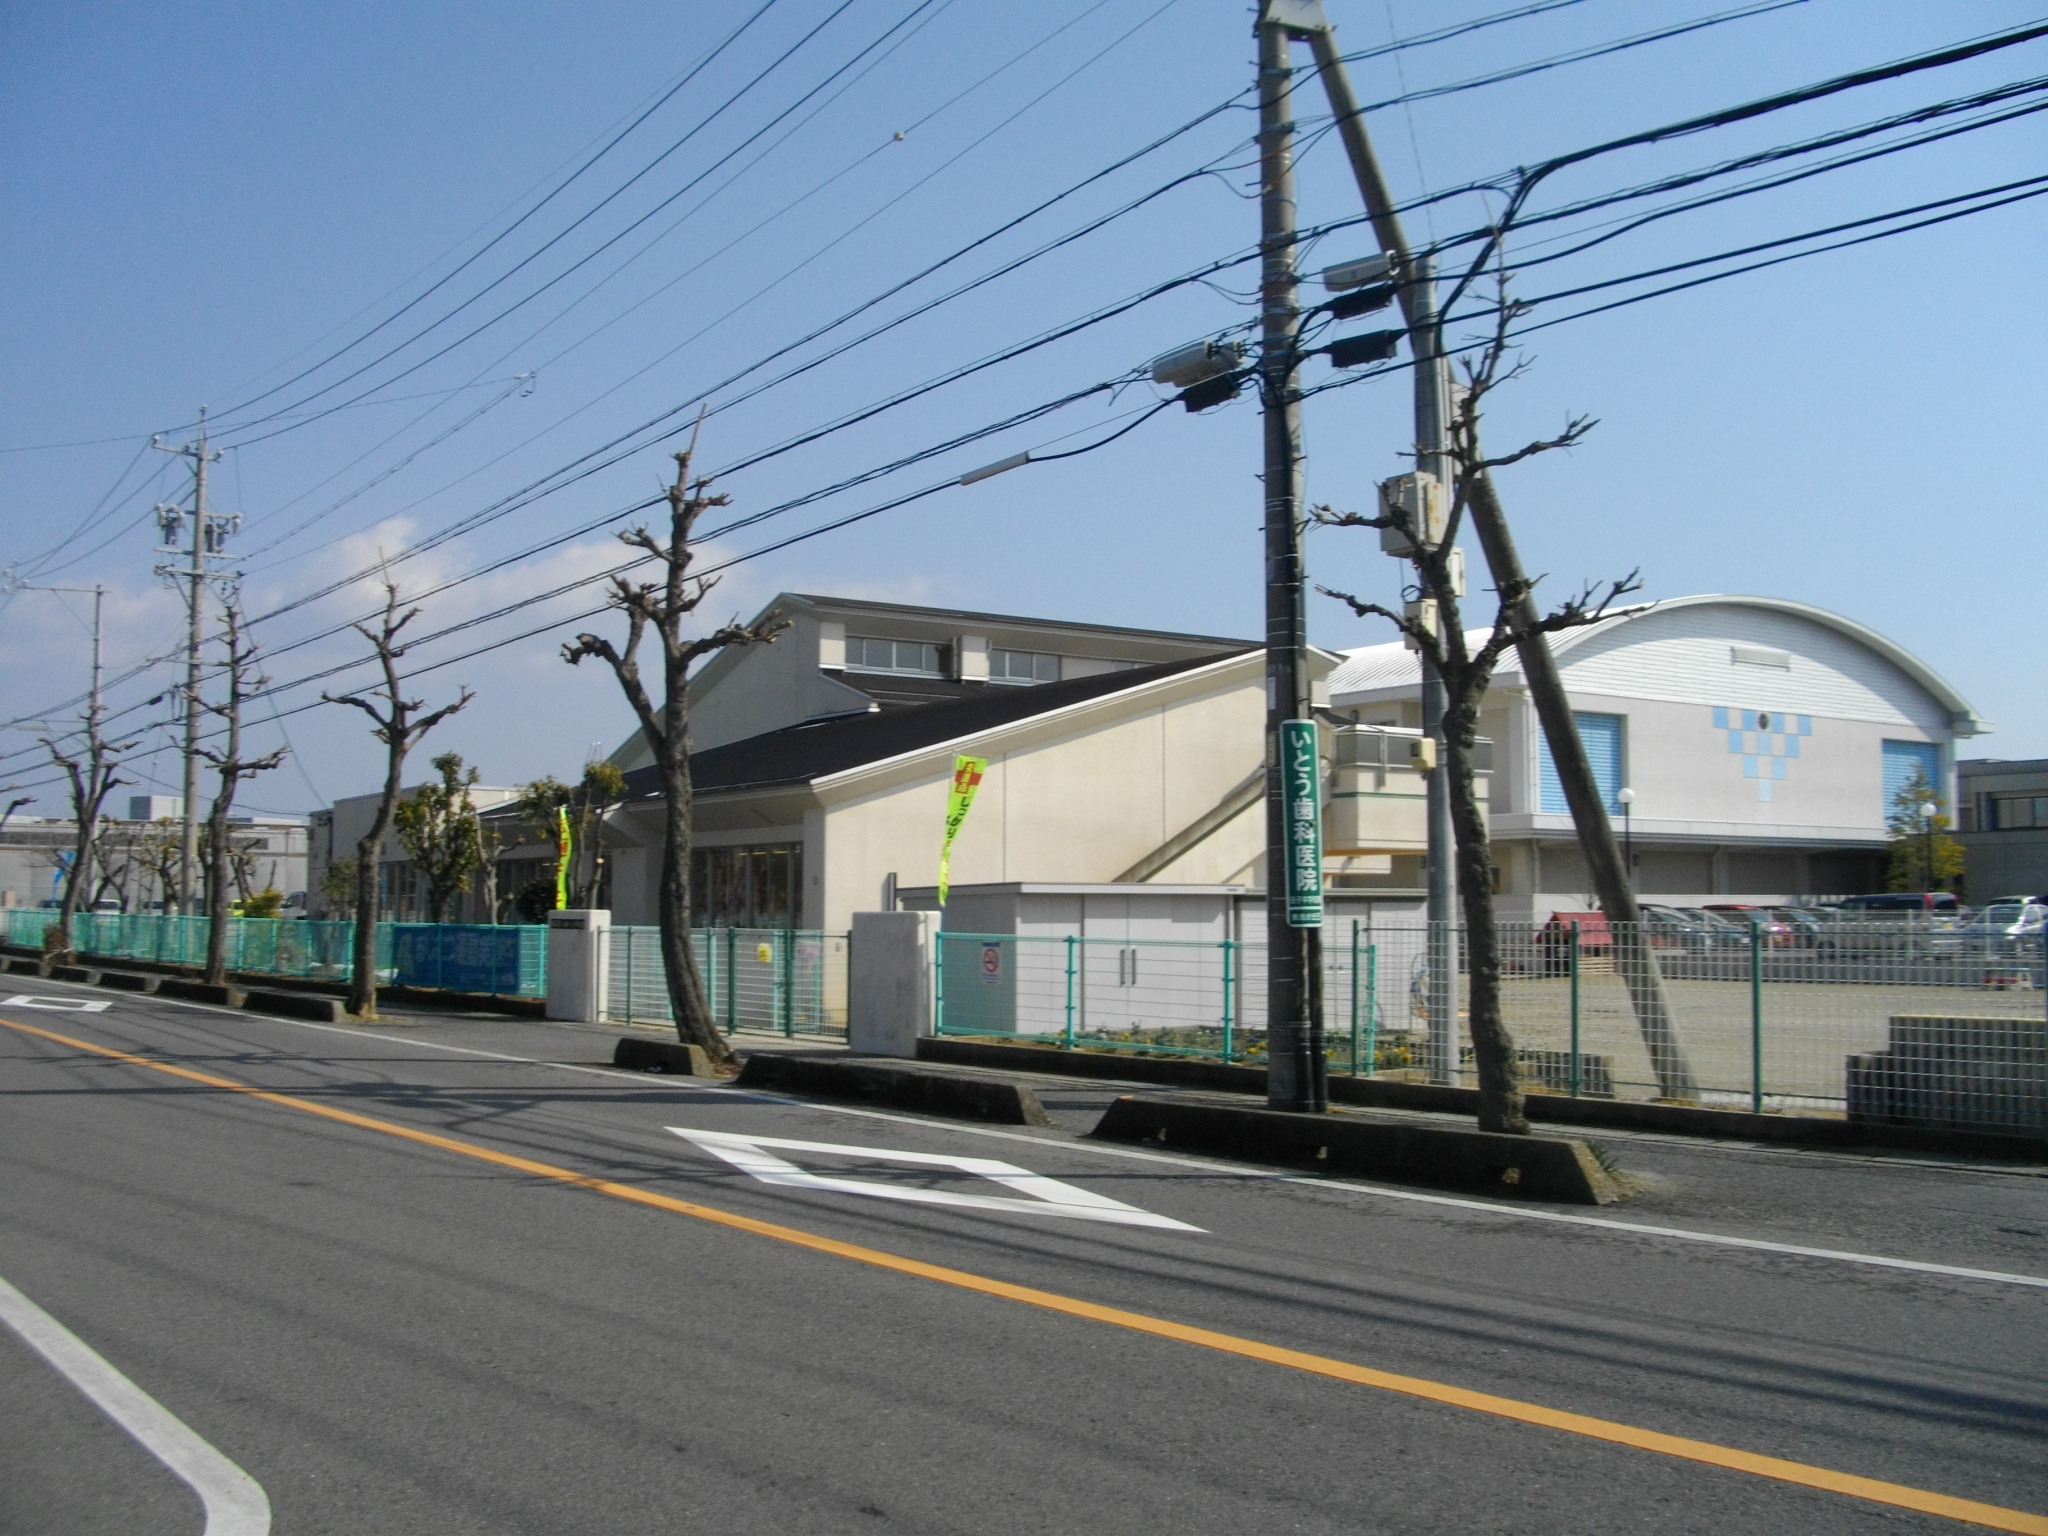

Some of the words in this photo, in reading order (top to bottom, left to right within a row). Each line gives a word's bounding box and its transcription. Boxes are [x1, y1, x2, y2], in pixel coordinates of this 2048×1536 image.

[1290, 730, 1318, 892] いとう歯科医院
